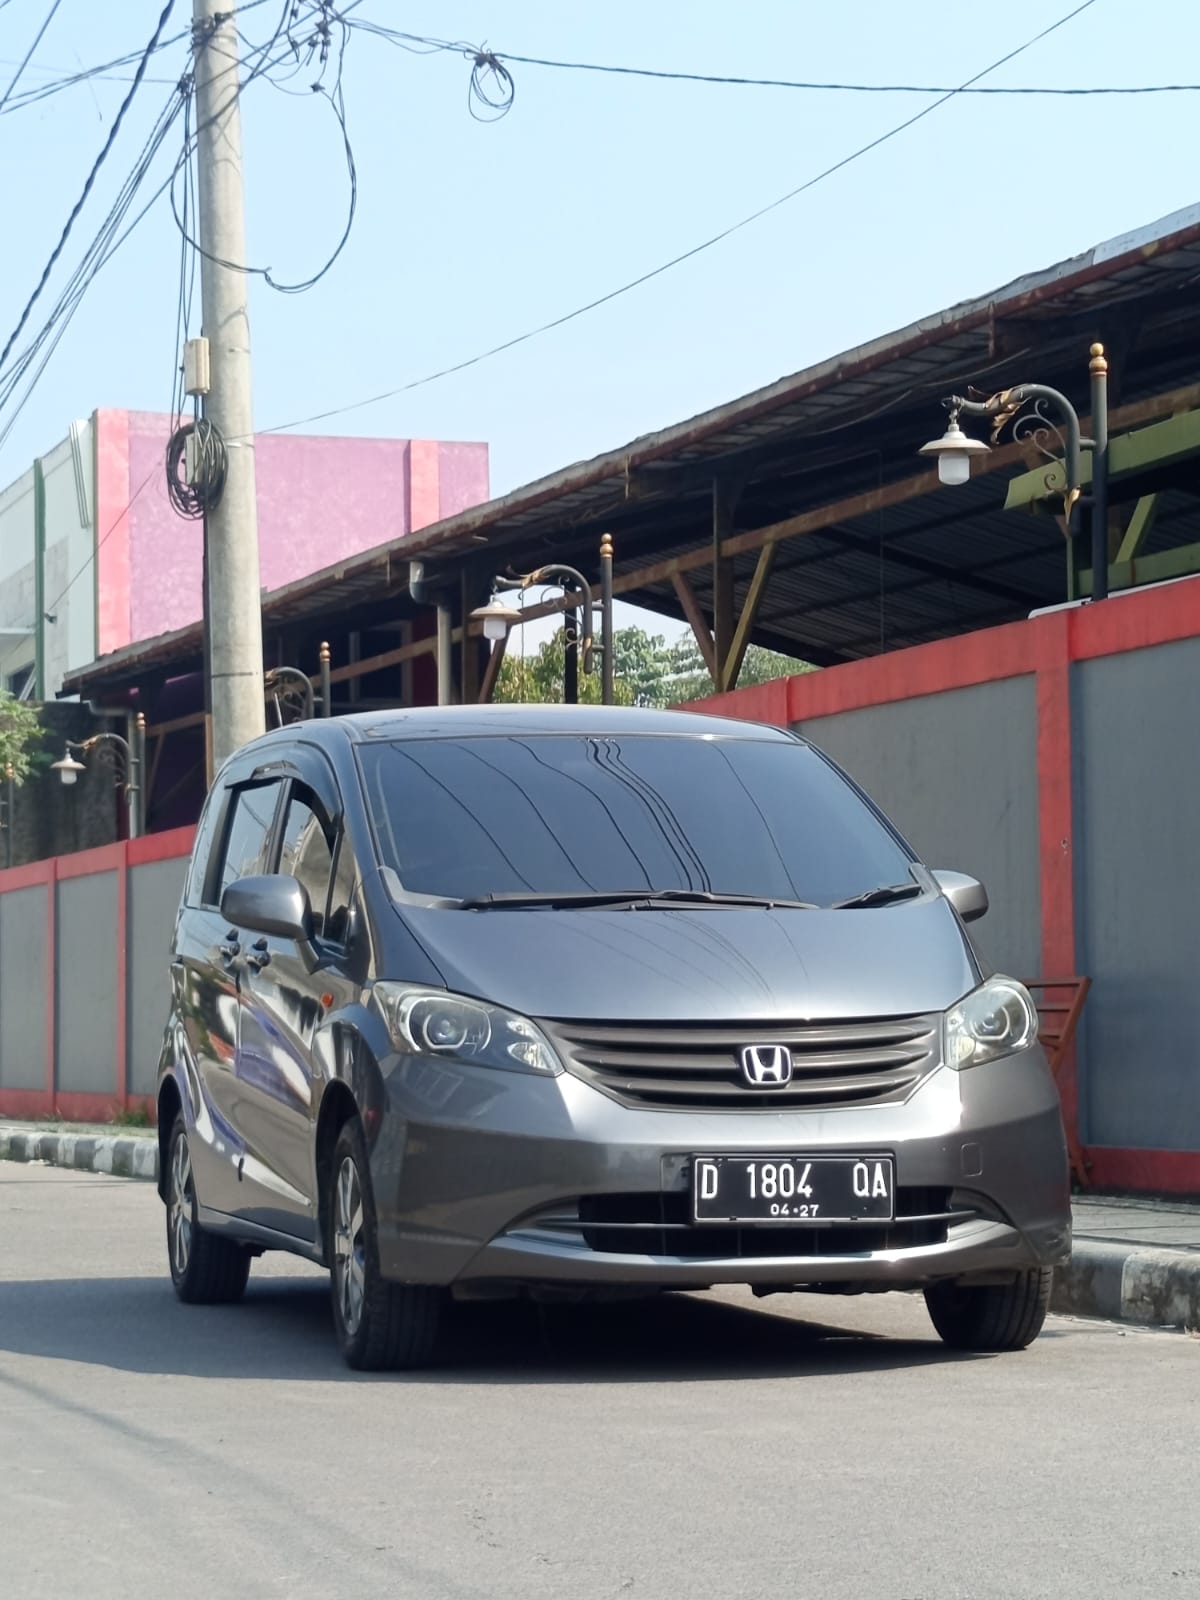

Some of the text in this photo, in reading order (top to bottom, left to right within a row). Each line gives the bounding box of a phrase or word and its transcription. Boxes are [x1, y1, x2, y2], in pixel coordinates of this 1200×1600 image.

[701, 1162, 888, 1199] D 1804 QA
